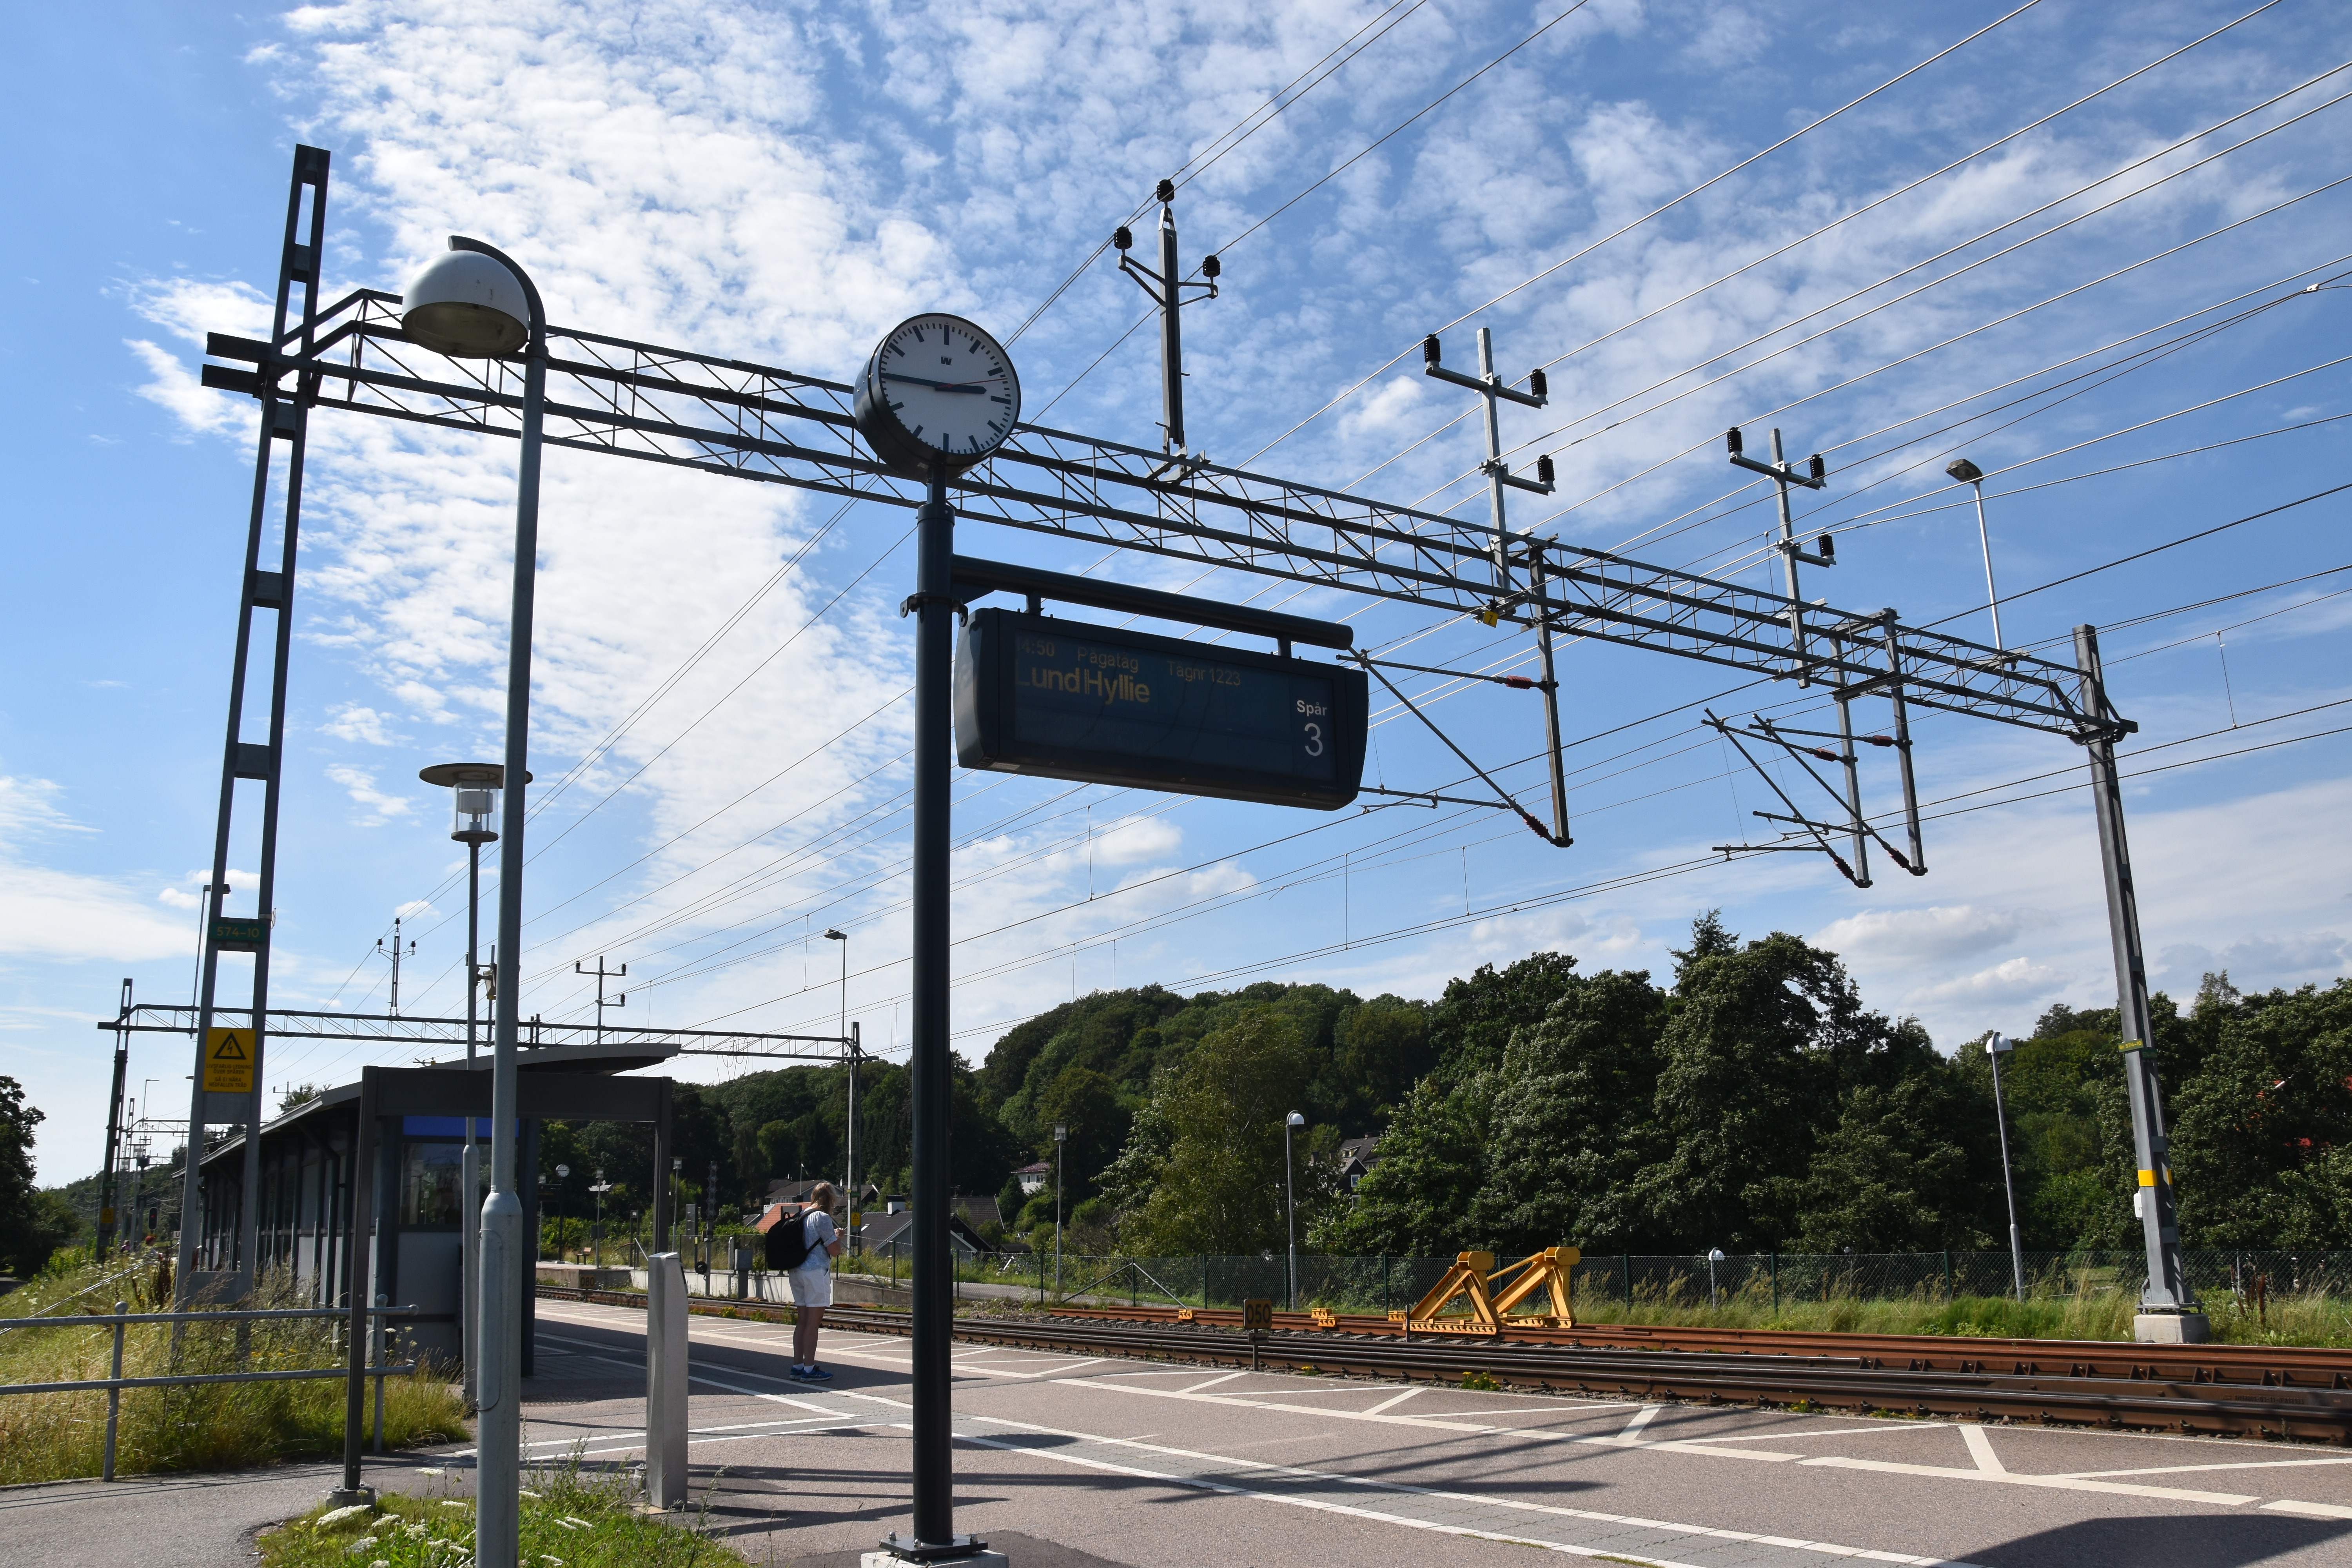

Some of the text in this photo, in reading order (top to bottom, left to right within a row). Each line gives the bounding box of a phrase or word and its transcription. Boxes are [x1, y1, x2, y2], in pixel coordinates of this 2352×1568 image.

[1078, 646, 1138, 673] Pågatåg
[1167, 661, 1241, 686] Tågnr 1223
[1296, 699, 1327, 717] Spår
[1304, 722, 1323, 757] 3
[217, 926, 260, 938] 574-10
[581, 1277, 595, 1287] 080
[1246, 1303, 1271, 1324] 050
